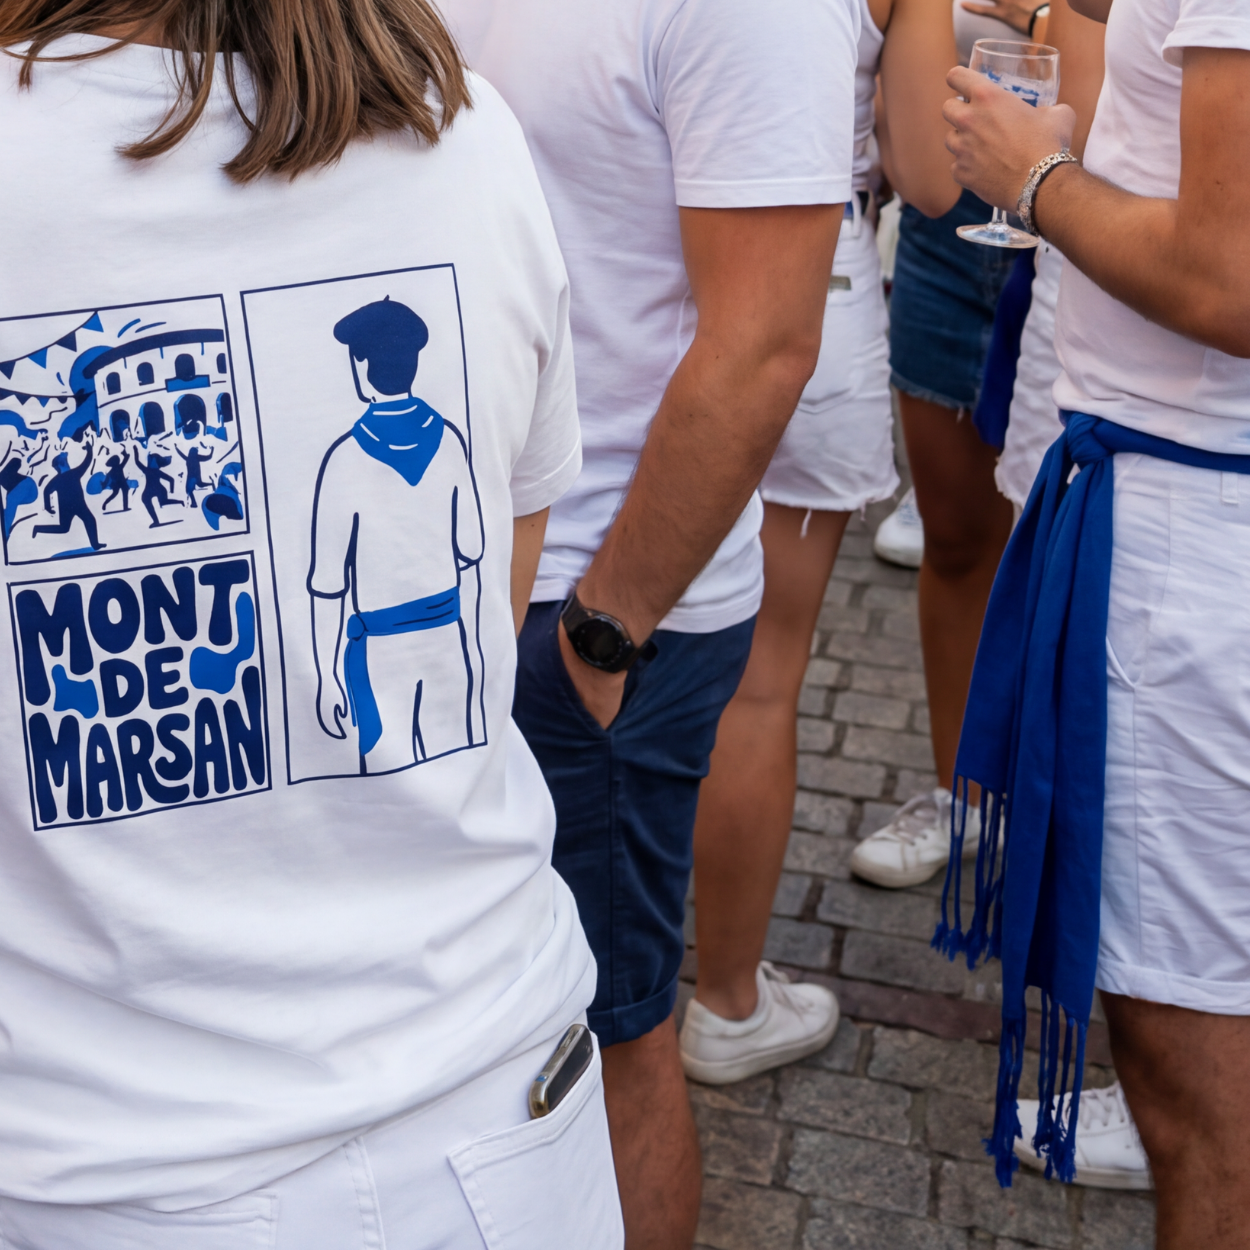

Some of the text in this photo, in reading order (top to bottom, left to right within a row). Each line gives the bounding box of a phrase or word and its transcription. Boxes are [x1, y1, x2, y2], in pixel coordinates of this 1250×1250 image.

[14, 559, 250, 706] MONT
[99, 646, 189, 718] DE
[28, 665, 267, 824] MARSAN
